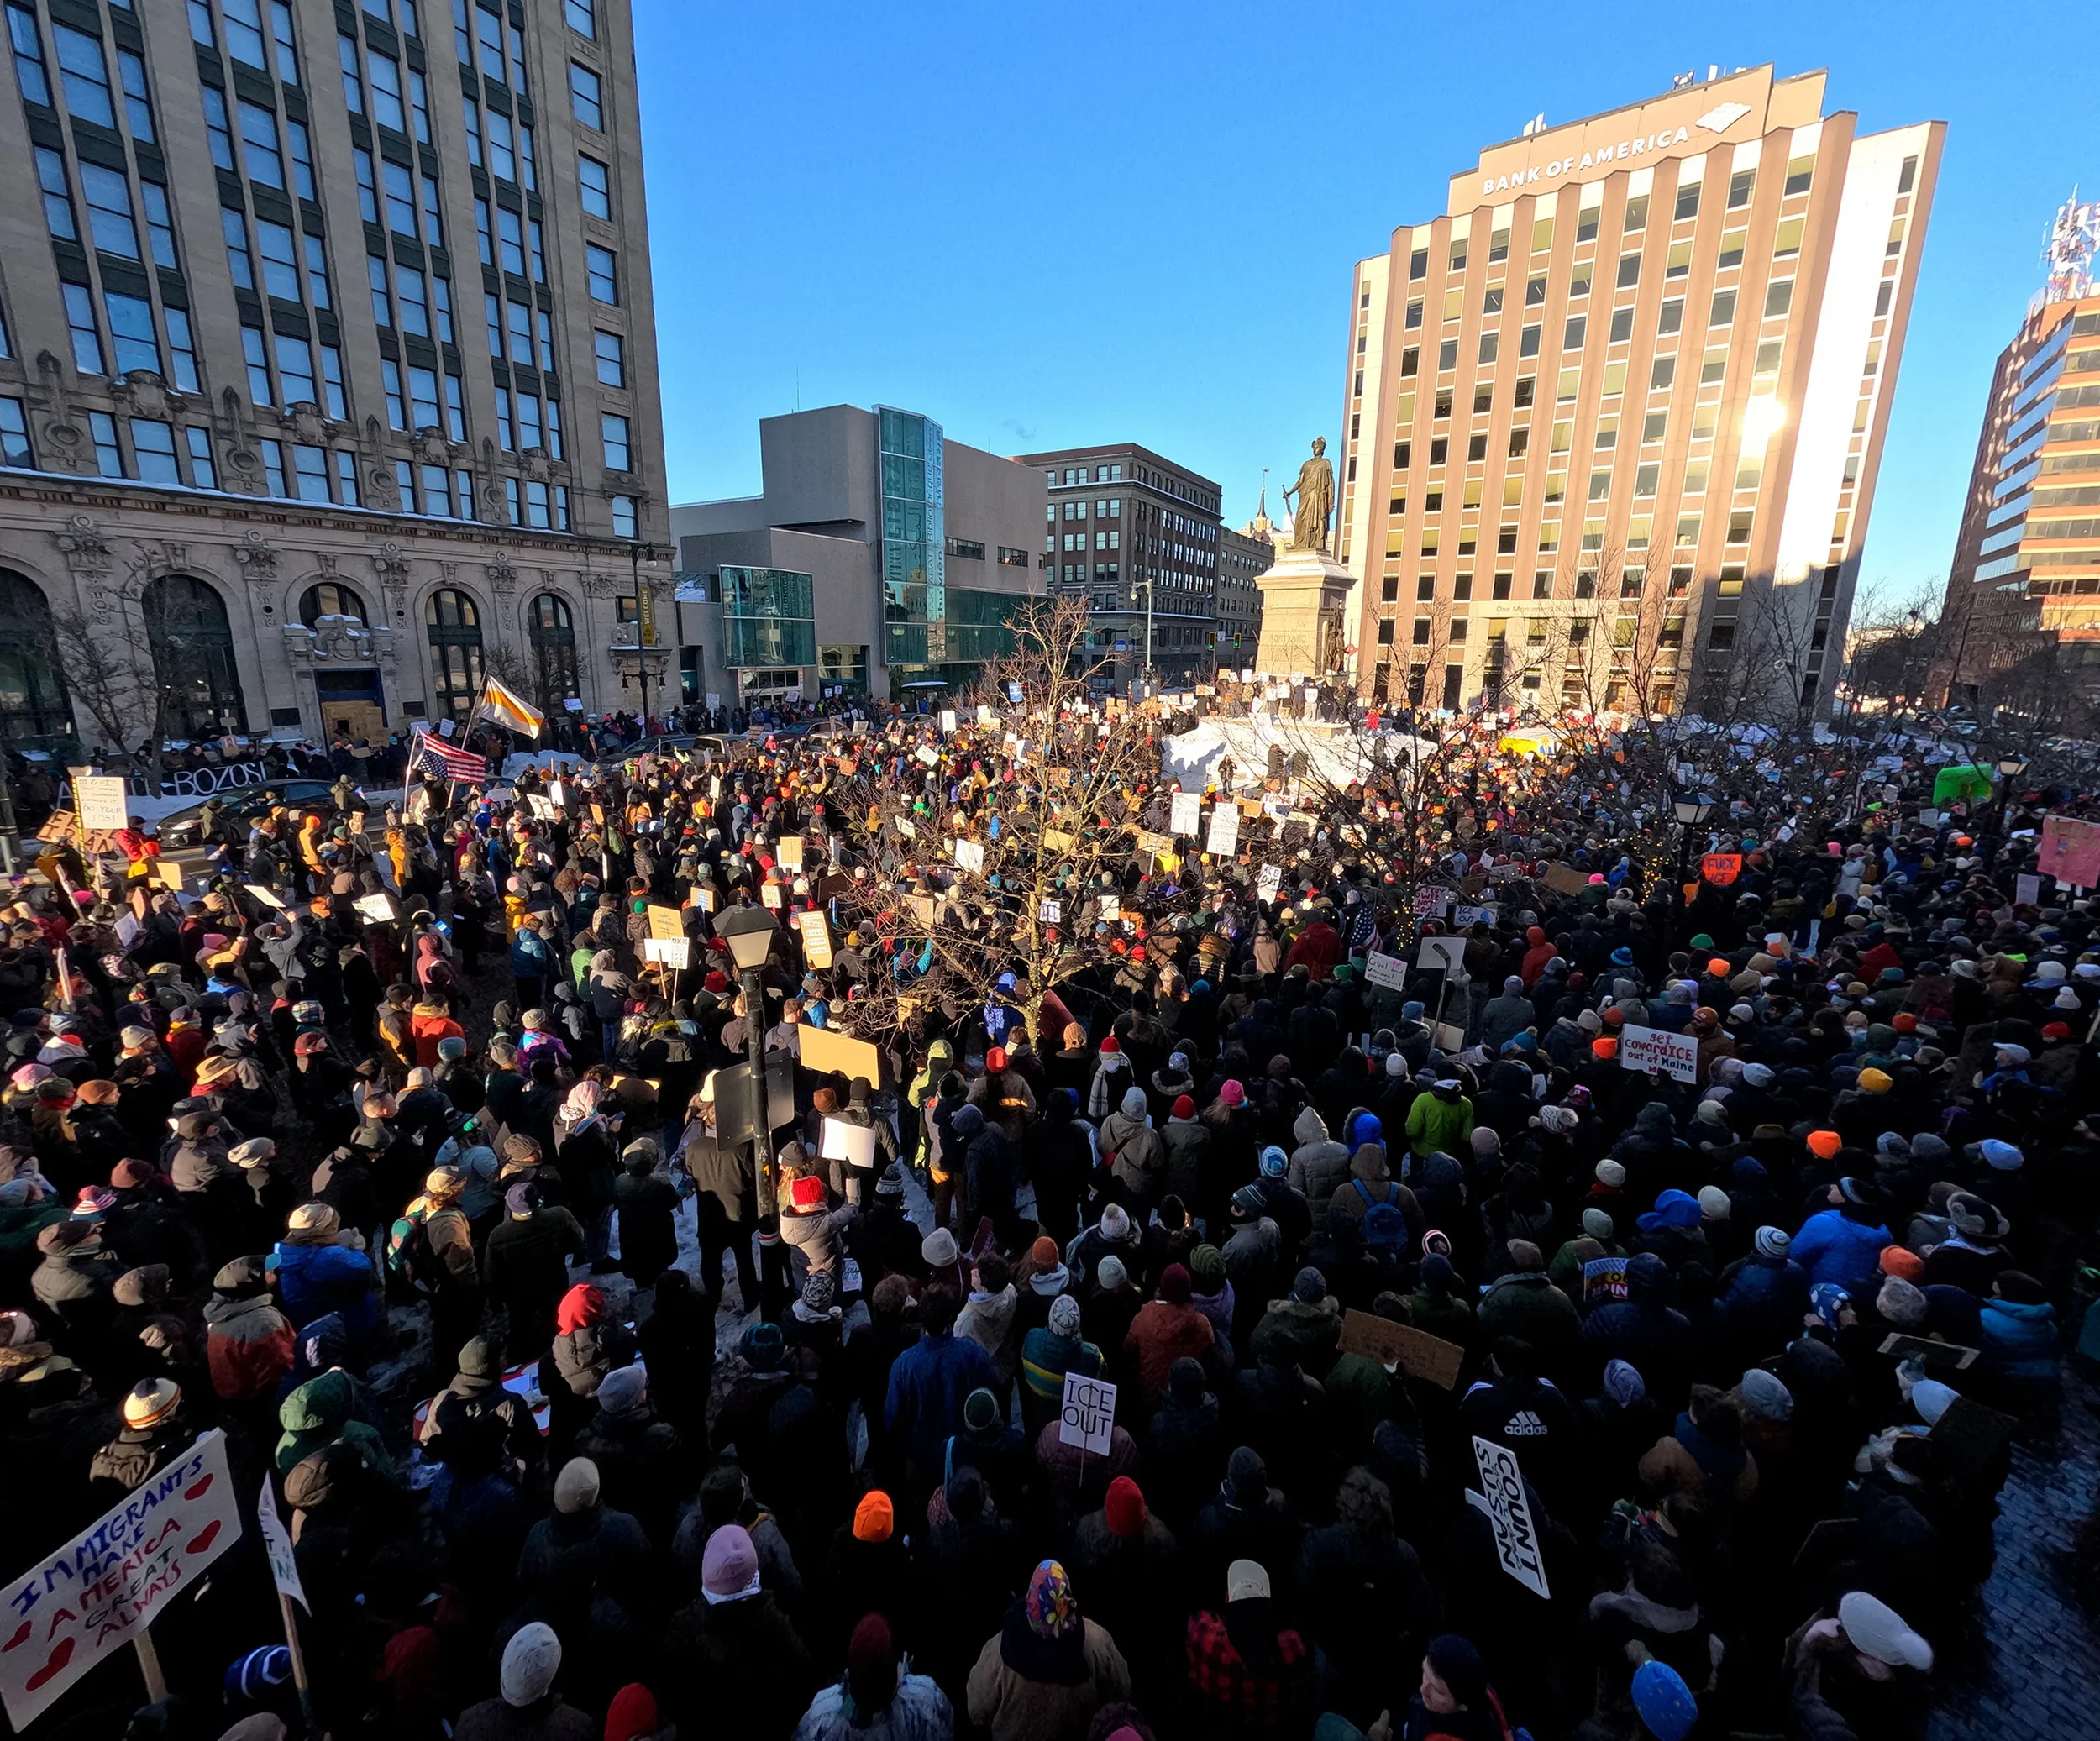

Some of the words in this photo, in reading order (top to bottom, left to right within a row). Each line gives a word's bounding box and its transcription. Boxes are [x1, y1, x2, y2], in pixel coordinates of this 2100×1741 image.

[1483, 165, 1541, 195] BANK
[1546, 157, 1575, 179] OF
[1579, 125, 1689, 170] AMERICA
[641, 590, 650, 625] WELCOME
[1496, 605, 1510, 613] One
[173, 761, 267, 796] BOZOS!
[1707, 857, 1737, 871] FUCK
[1457, 906, 1473, 915] ICE
[1649, 1033, 1674, 1045] get
[1627, 1051, 1645, 1061] out
[1646, 1054, 1659, 1064] of
[1662, 1057, 1695, 1072] Maine
[1066, 1379, 1115, 1414] ICE
[1063, 1406, 1112, 1437] OUT
[1504, 1425, 1548, 1435] adidas
[1475, 1441, 1516, 1570] SUSAN
[1497, 1453, 1544, 1589] COUNT
[10, 1454, 204, 1618] IMMIGRANTS
[81, 1521, 145, 1587] MAKE
[47, 1517, 182, 1643] AMERICA
[84, 1545, 175, 1630] GREAT
[96, 1559, 182, 1649] ALWAYS
